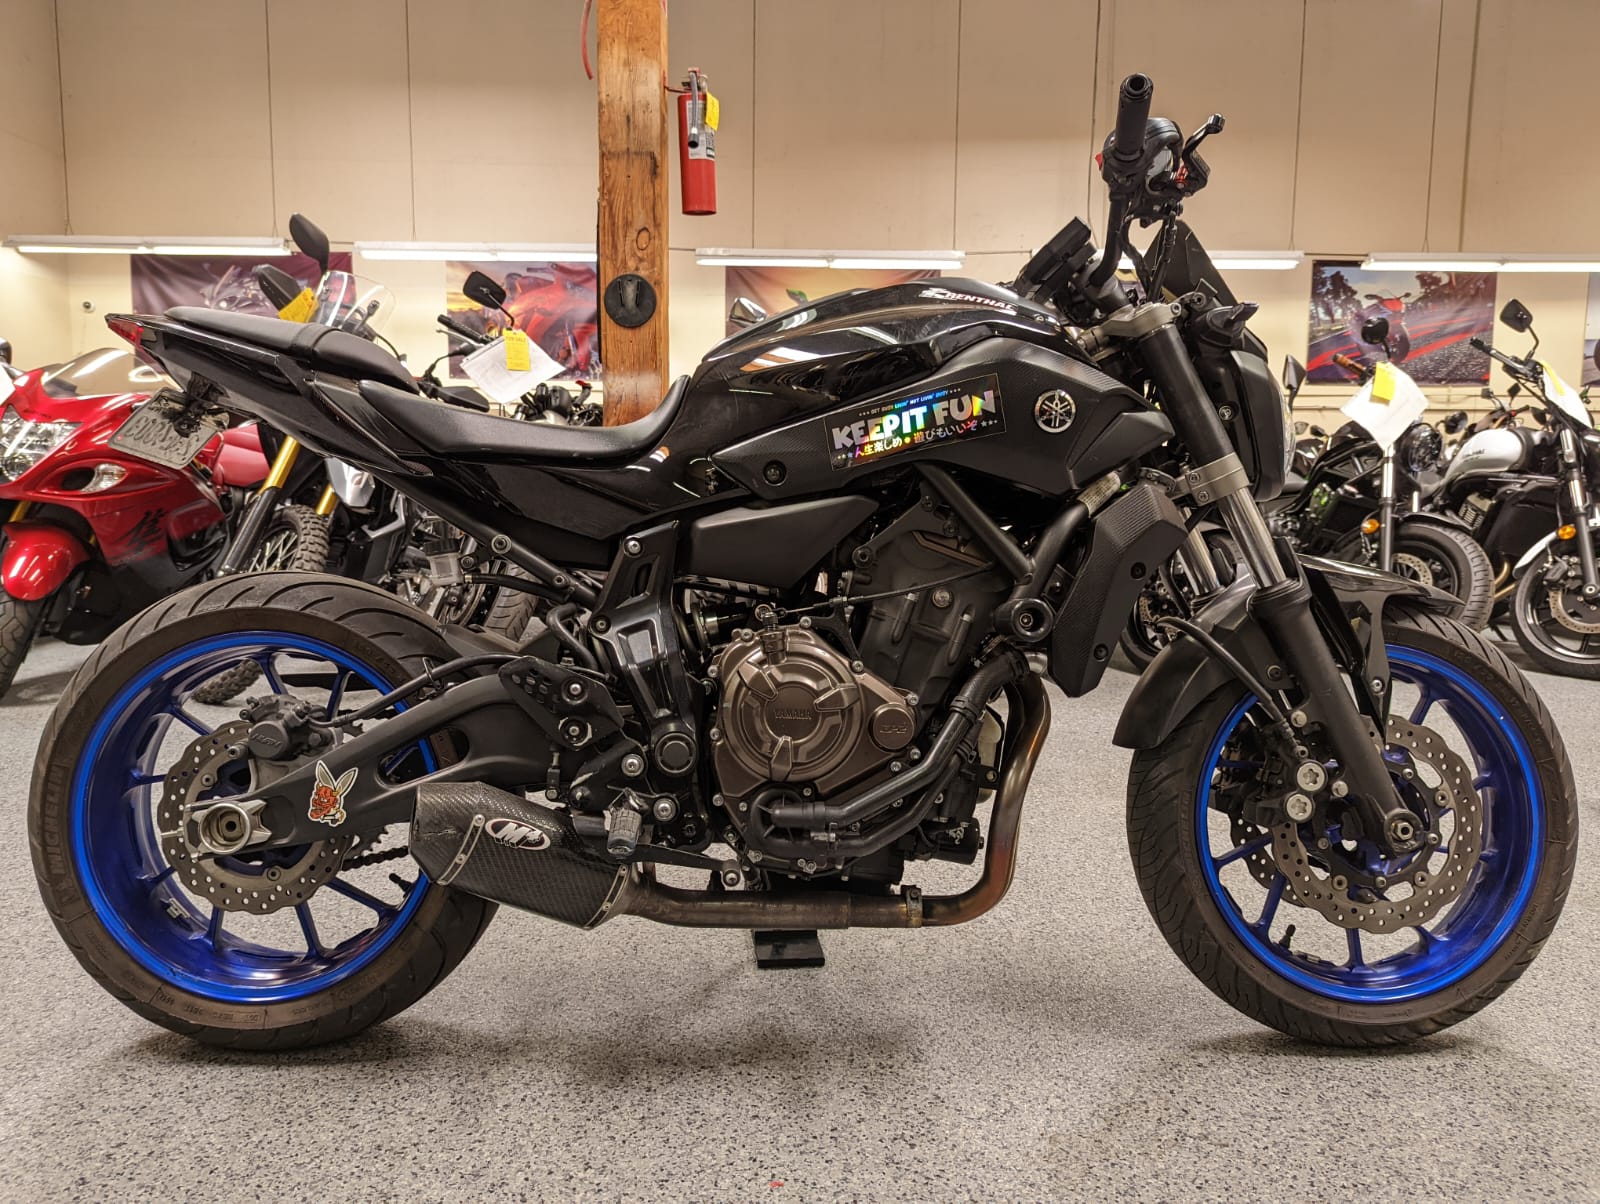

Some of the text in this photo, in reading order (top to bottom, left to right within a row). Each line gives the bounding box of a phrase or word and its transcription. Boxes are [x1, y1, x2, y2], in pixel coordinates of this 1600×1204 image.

[941, 289, 1018, 311] RENTHAL
[933, 389, 996, 425] FUN
[773, 708, 814, 721] YAMAHA
[44, 766, 65, 875] MICHELIN
